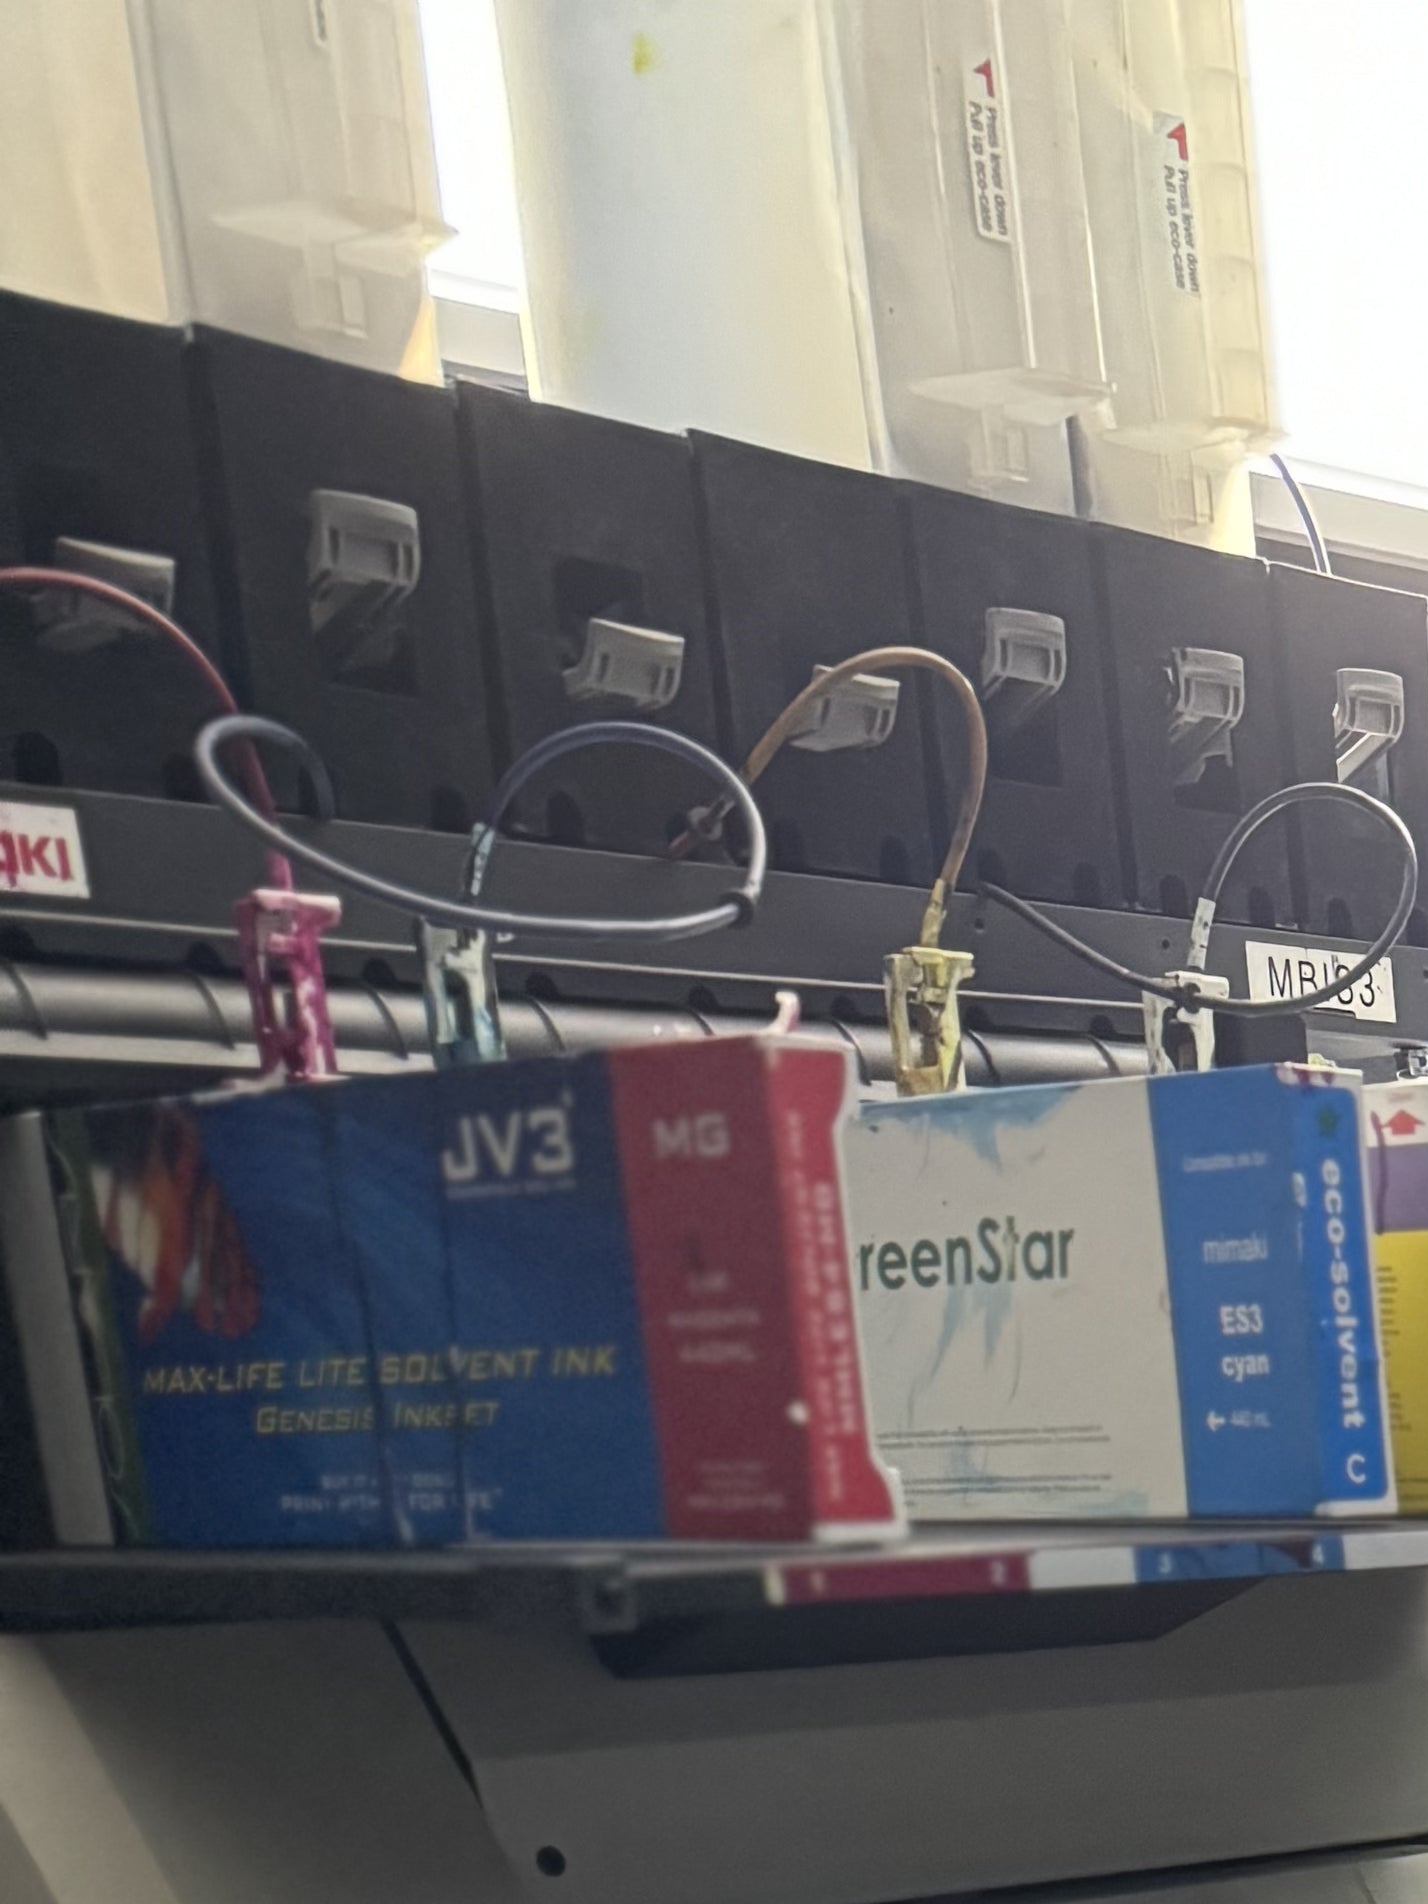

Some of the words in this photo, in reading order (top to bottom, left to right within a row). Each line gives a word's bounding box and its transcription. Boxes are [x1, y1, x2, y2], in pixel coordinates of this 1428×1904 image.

[967, 101, 982, 130] Pull
[986, 106, 999, 148] Press
[971, 135, 985, 156] up
[990, 152, 1004, 190] lever
[1163, 164, 1177, 194] Pull
[1178, 168, 1190, 208] Press
[974, 159, 994, 233] eco-case
[994, 194, 1009, 236] down
[1166, 197, 1178, 216] up
[1182, 213, 1195, 249] lever
[1168, 220, 1186, 290] eco-case
[1187, 252, 1201, 293] down
[440, 1107, 574, 1182] JV3
[652, 1112, 731, 1159] MG
[1203, 1232, 1268, 1264] mimaki
[1320, 1159, 1366, 1429] eco-solvent
[1220, 1304, 1263, 1334] ES3
[298, 1356, 368, 1388] LITE
[379, 1347, 541, 1385] SOLVENT
[551, 1346, 618, 1376] INK
[1221, 1353, 1270, 1382] cyan
[1345, 1453, 1366, 1484] C
